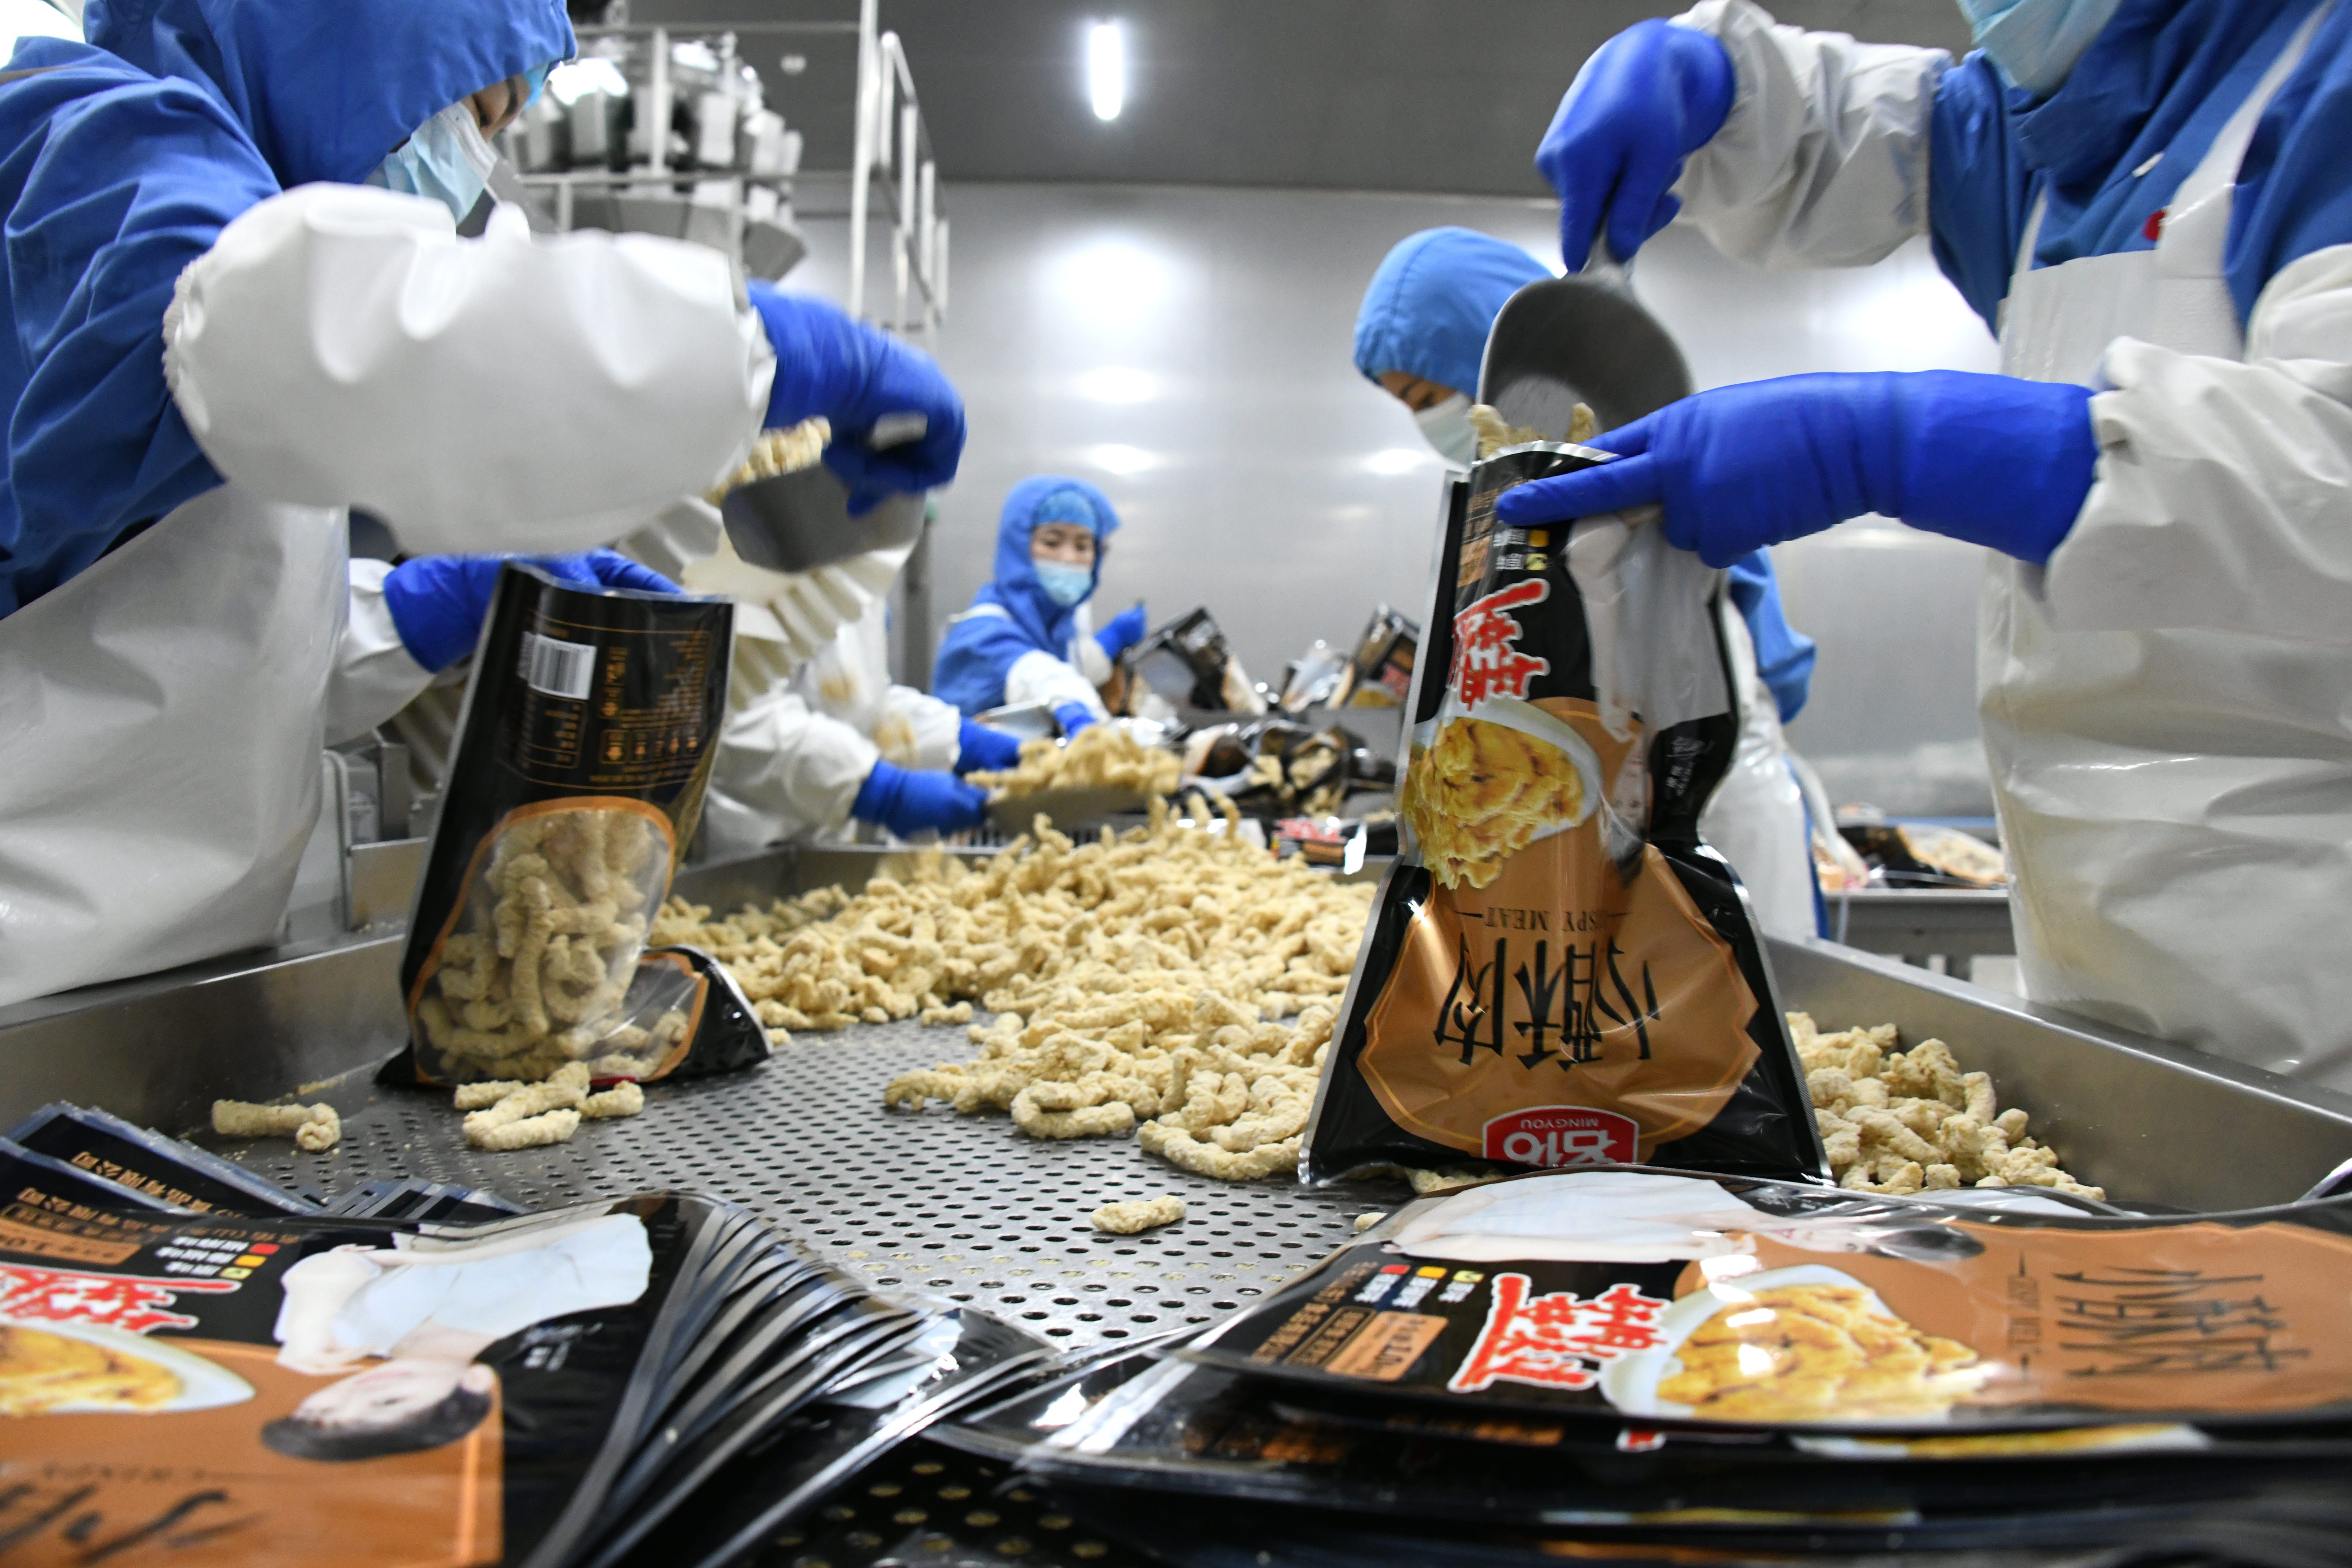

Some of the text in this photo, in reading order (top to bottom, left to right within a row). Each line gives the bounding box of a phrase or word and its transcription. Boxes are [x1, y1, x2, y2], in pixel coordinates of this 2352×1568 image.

[1484, 907, 1549, 932] MEAT
[1434, 933, 1661, 1072] 小酥肉
[1520, 1118, 1599, 1129] MINGYOU
